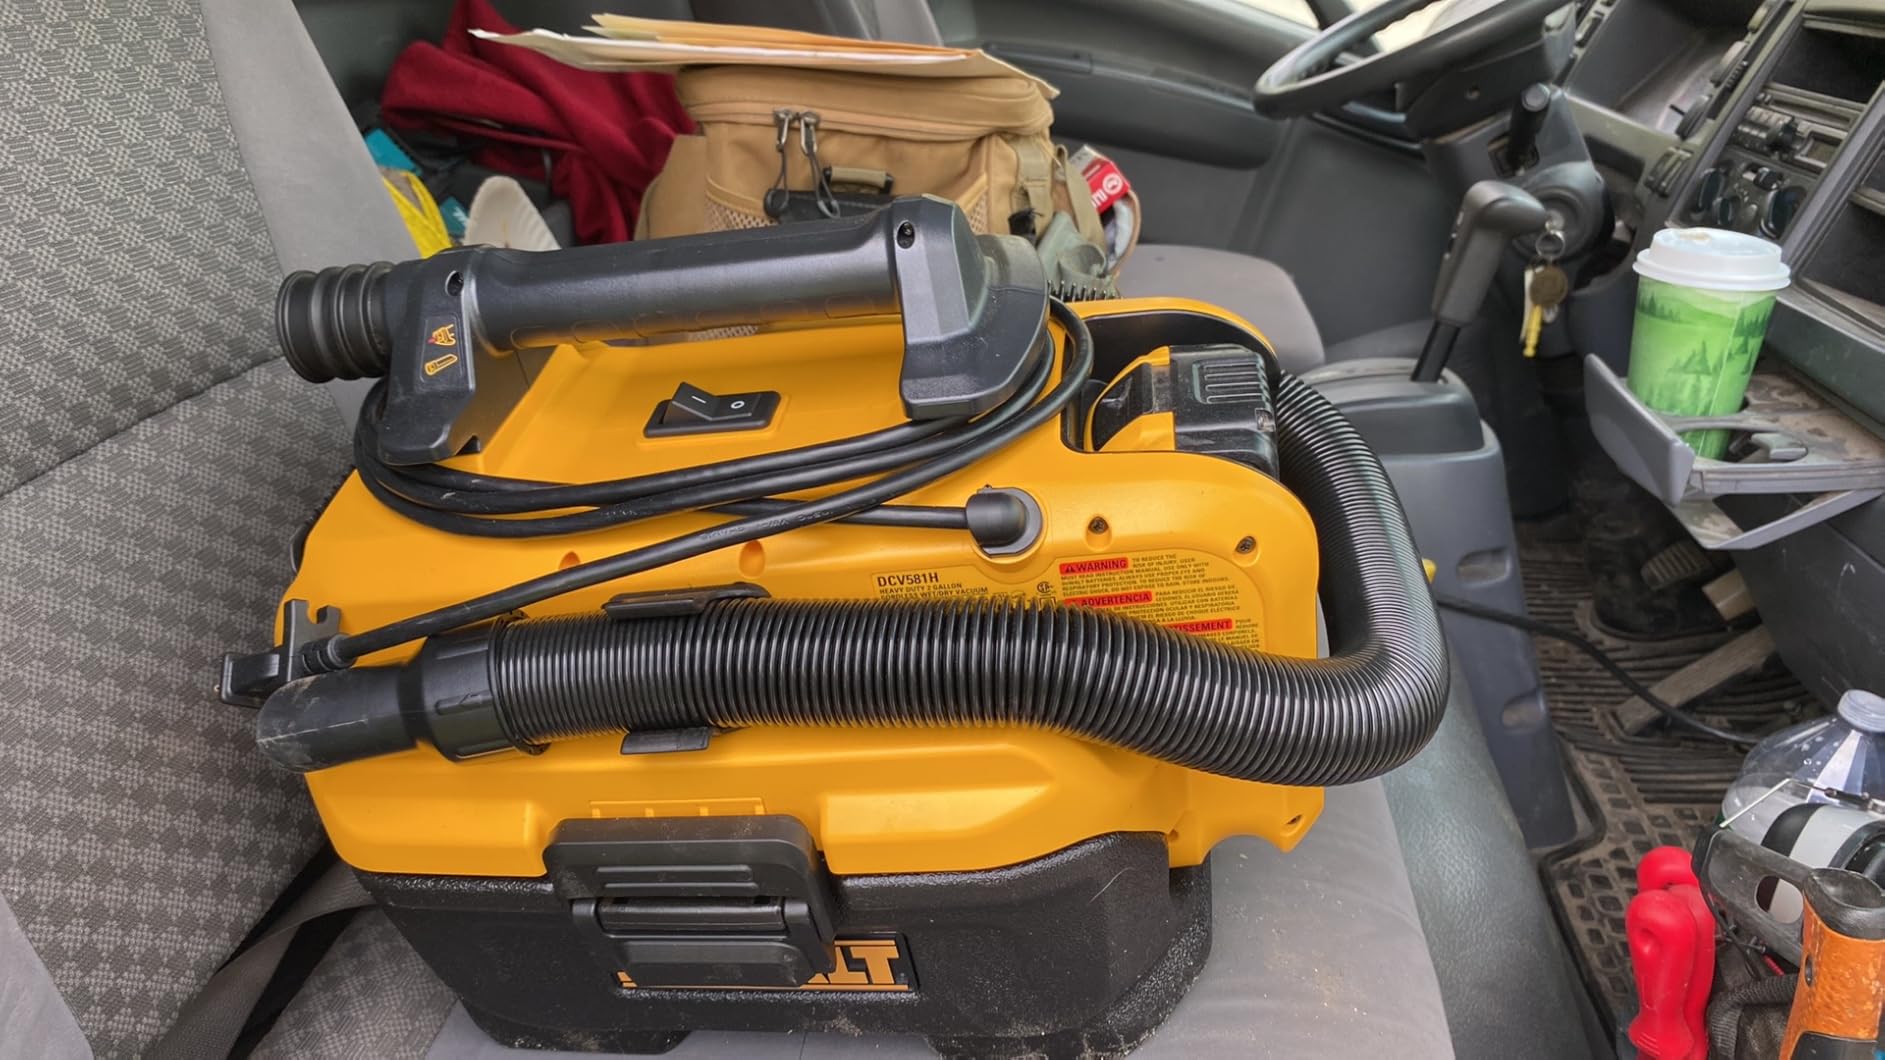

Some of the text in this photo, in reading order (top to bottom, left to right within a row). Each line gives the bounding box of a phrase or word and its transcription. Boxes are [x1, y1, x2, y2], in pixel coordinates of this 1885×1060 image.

[1077, 559, 1127, 571] WARNING
[877, 572, 939, 587] DCV581H
[881, 592, 919, 600] CORDLESS
[956, 587, 988, 595] VACUUM
[1082, 592, 1149, 607] ADVERTENCIA
[1170, 620, 1230, 632] TISSEMENT
